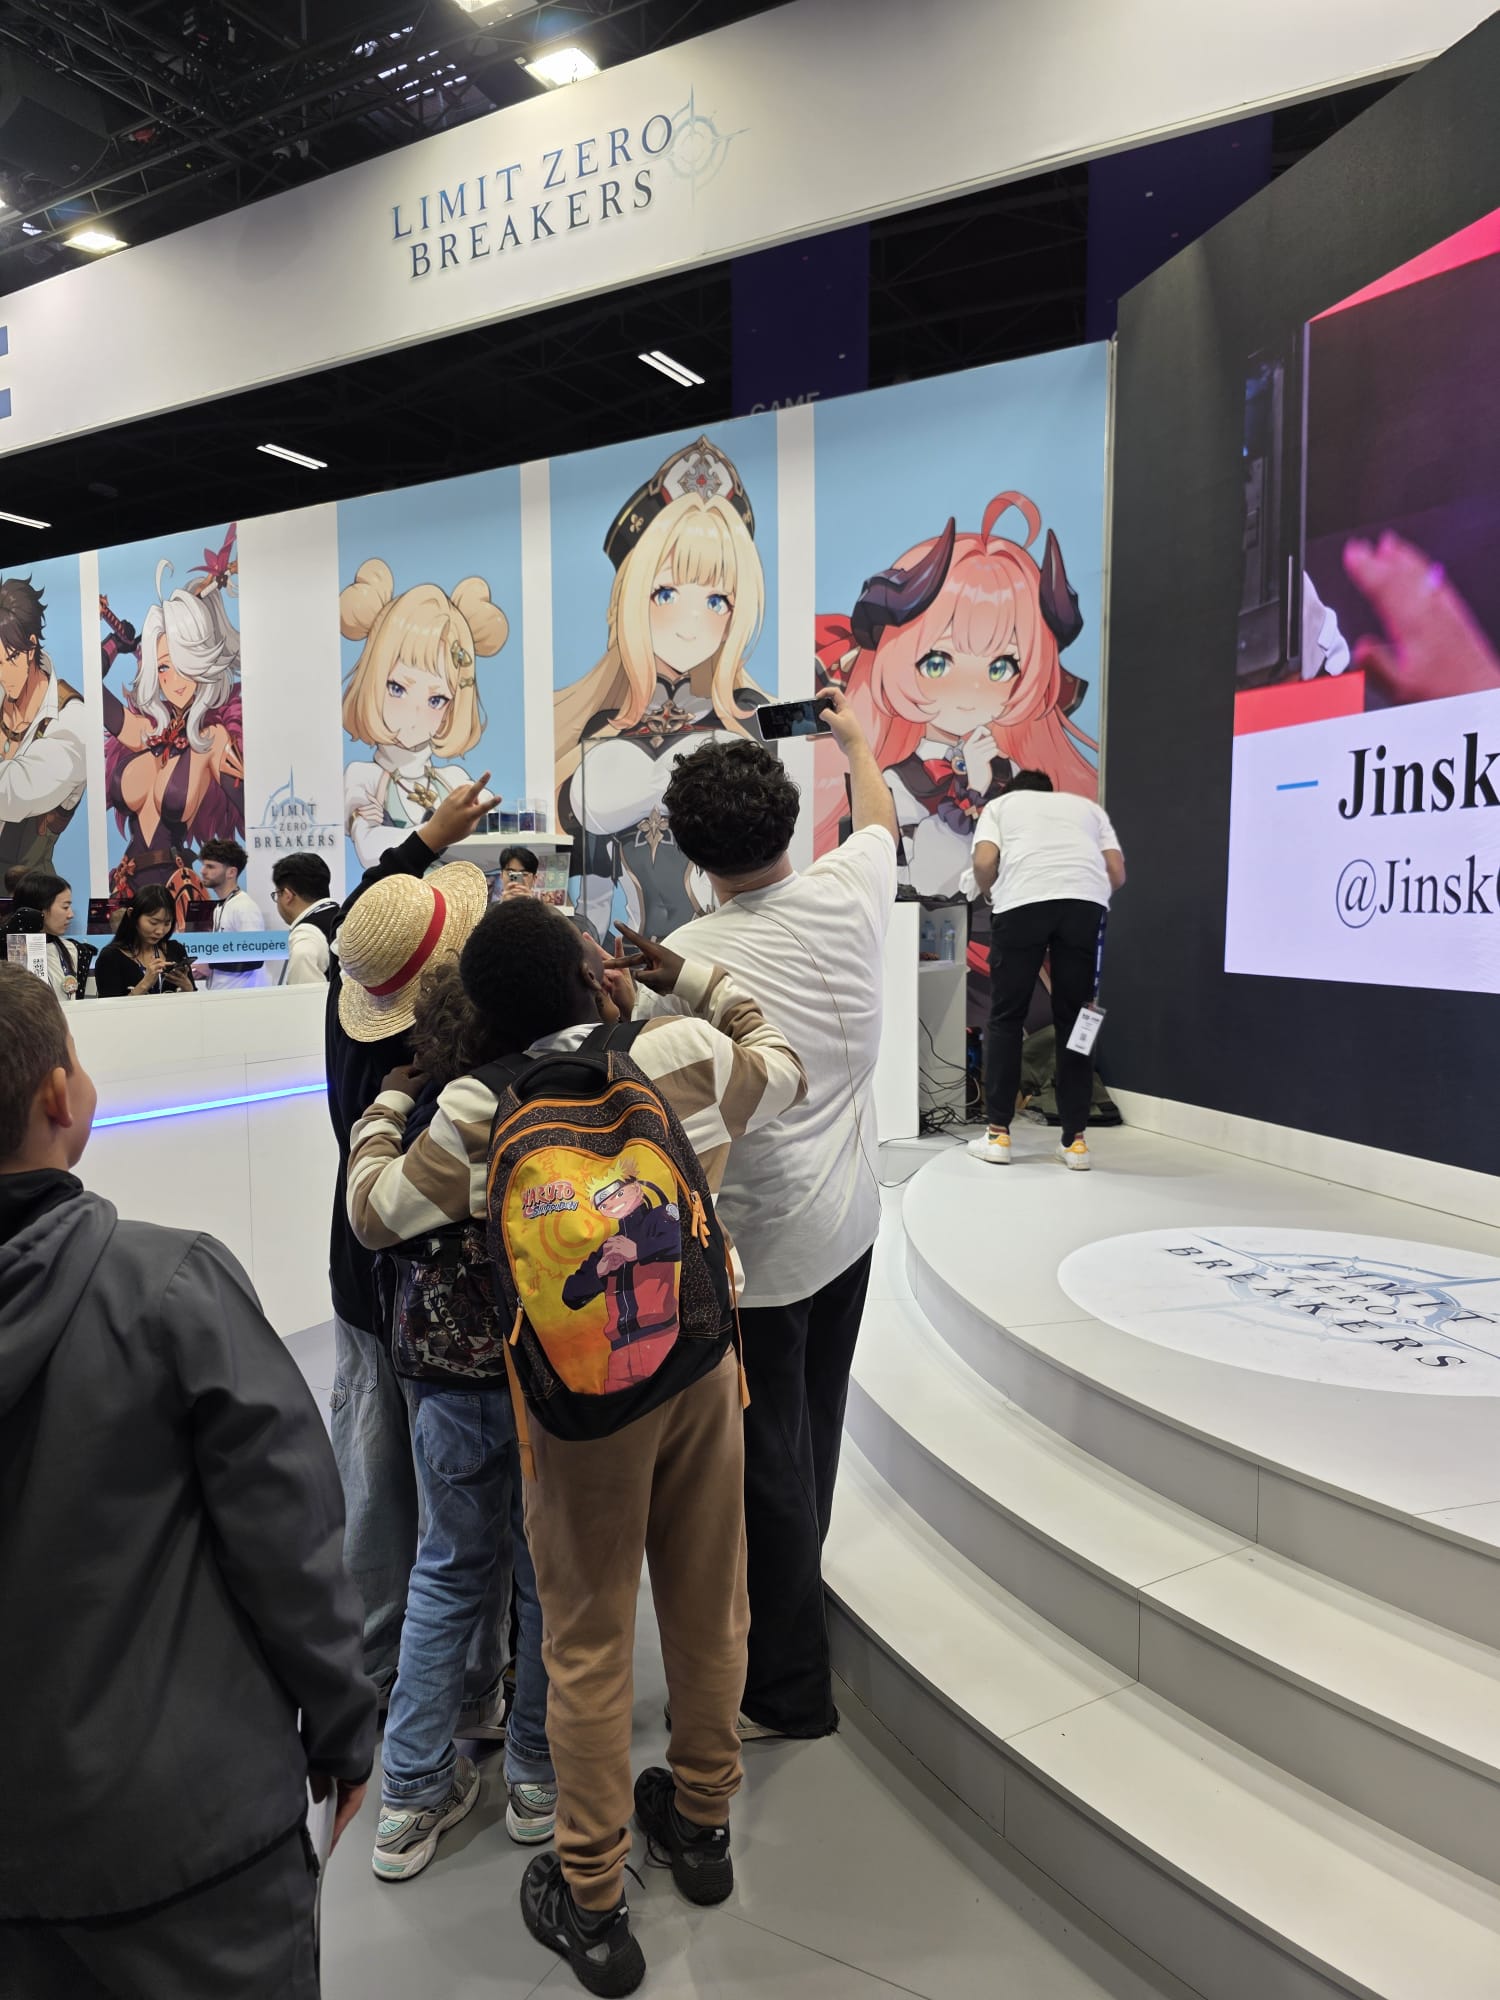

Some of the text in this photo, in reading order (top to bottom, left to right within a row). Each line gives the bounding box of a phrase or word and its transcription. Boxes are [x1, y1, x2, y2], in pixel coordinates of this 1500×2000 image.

[392, 114, 673, 240] LIMIT ZERO
[410, 169, 652, 279] BREAKERS
[1338, 732, 1500, 820] Jinsk
[254, 834, 336, 849] BREAKERS
[271, 803, 317, 817] LIMIT
[279, 822, 308, 832] ZERO
[1336, 855, 1500, 929] @Jinsk
[182, 940, 287, 956] hange et récupère
[1164, 1245, 1468, 1368] BREAKERS
[1287, 1274, 1398, 1317] ZERO
[1308, 1260, 1497, 1324] LIMIT
